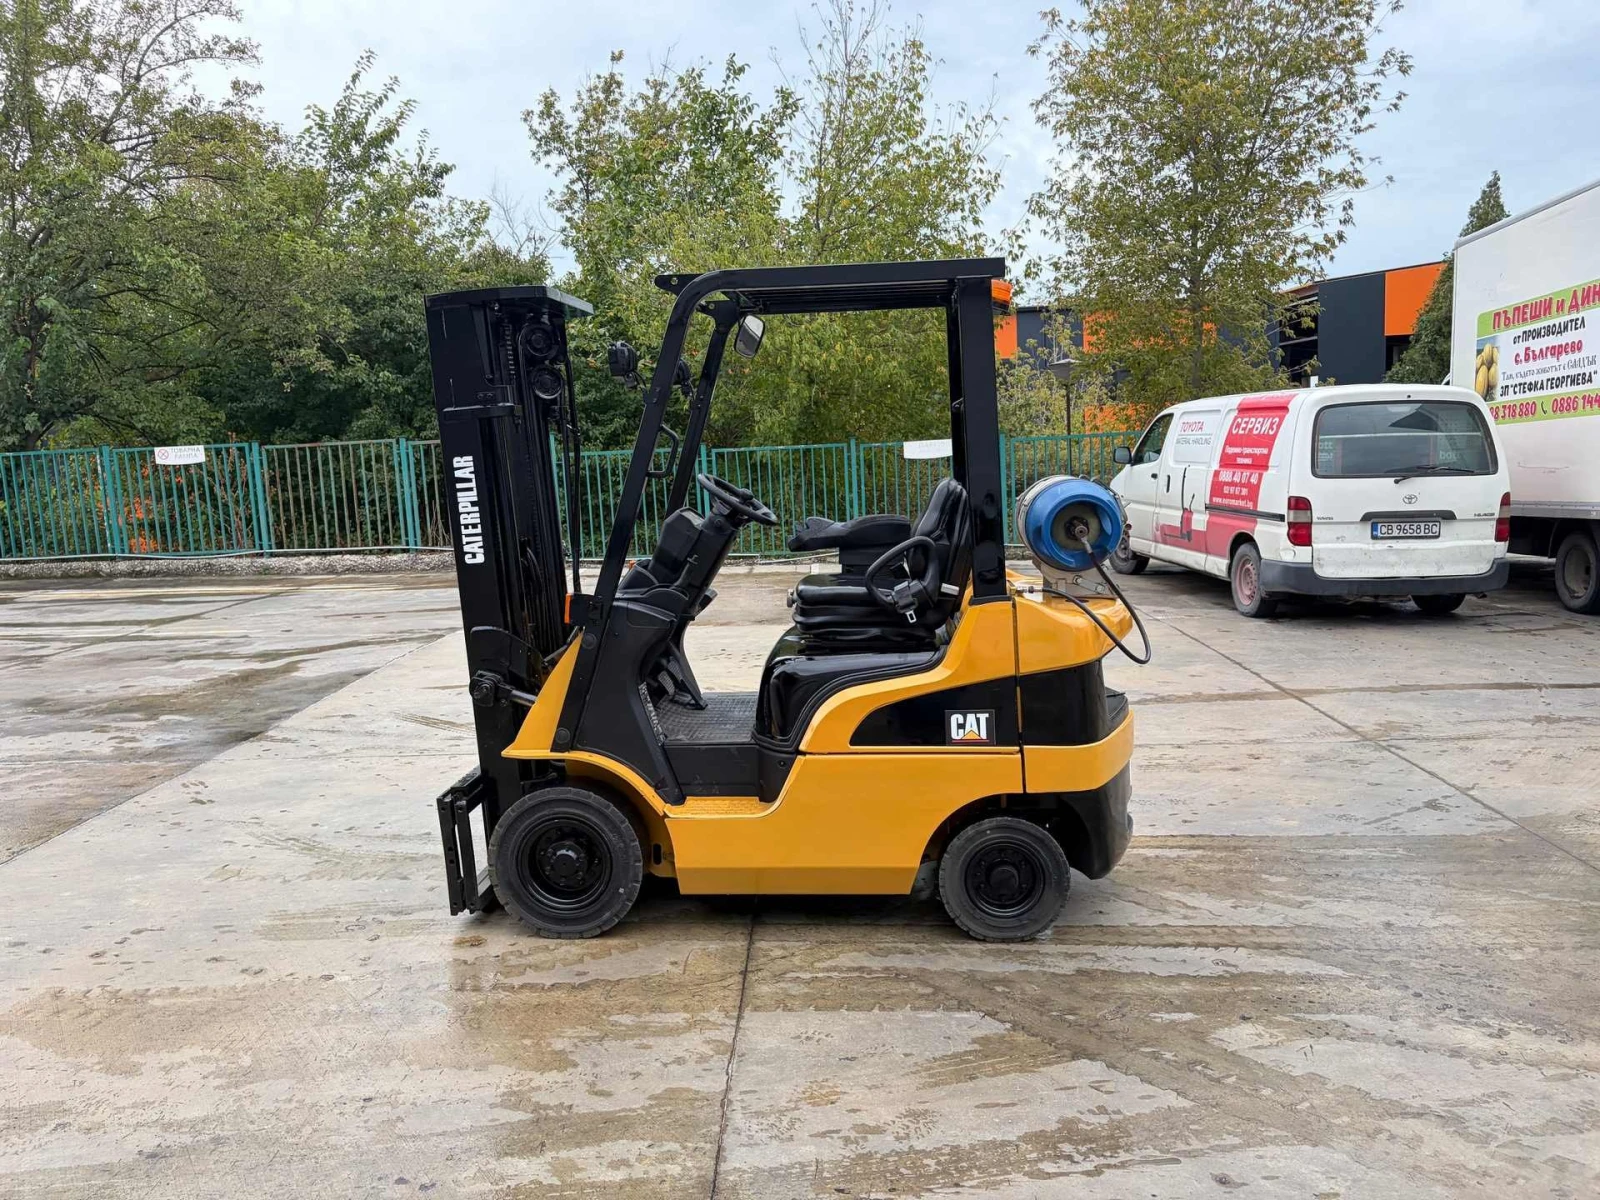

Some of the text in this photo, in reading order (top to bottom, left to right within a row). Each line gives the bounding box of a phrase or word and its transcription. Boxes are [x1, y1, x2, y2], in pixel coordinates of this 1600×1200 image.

[1493, 297, 1553, 330] ПЪПЕШИ
[1556, 299, 1564, 313] и
[1513, 316, 1585, 344] от ПРОИЗВОДИТЕЛ
[1524, 340, 1583, 361] Българево
[1501, 403, 1517, 419] 318
[1518, 401, 1537, 417] 880
[1552, 396, 1579, 413] 0886
[1181, 421, 1204, 432] TOYOTA
[1232, 417, 1278, 435] СЕРВИЗ
[1191, 436, 1211, 445] HANDLING
[1250, 472, 1259, 485] 40
[453, 455, 485, 564] CATERPILLAR
[1380, 523, 1438, 535] CB 9658 BC
[950, 713, 989, 740] CAT
